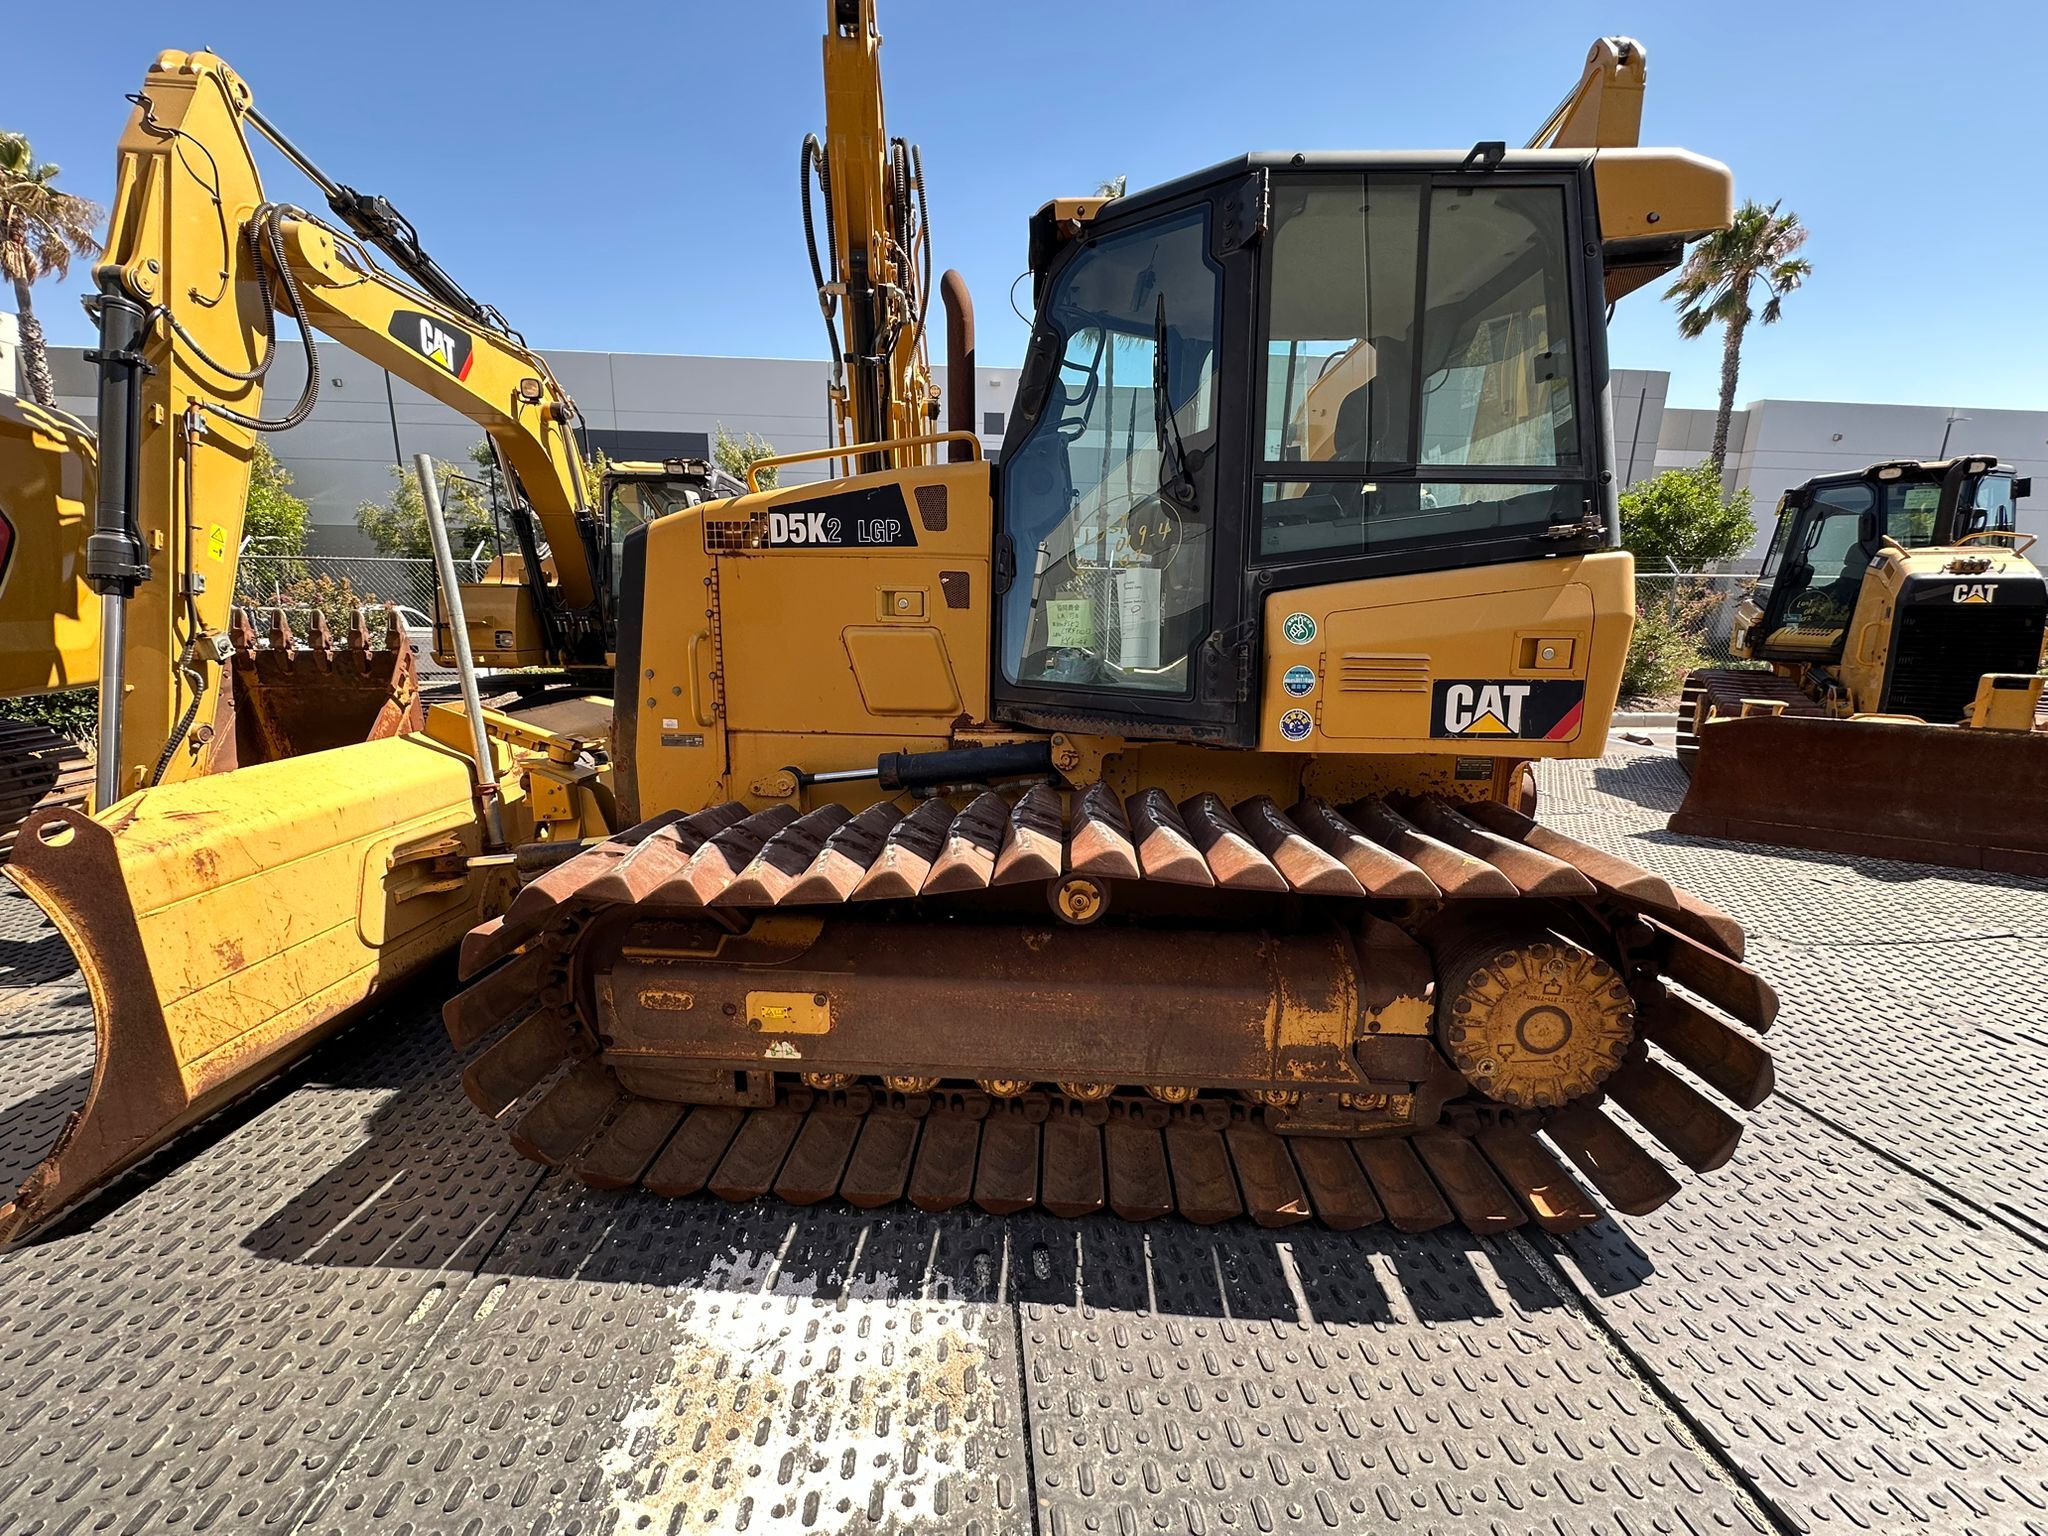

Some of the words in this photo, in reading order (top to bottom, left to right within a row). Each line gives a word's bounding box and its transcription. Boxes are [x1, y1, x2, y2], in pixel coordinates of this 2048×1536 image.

[420, 318, 455, 372] CAT
[769, 512, 842, 543] D5K2
[857, 519, 901, 543] LGP
[1952, 584, 1998, 603] CAT
[1444, 684, 1531, 734] CAT
